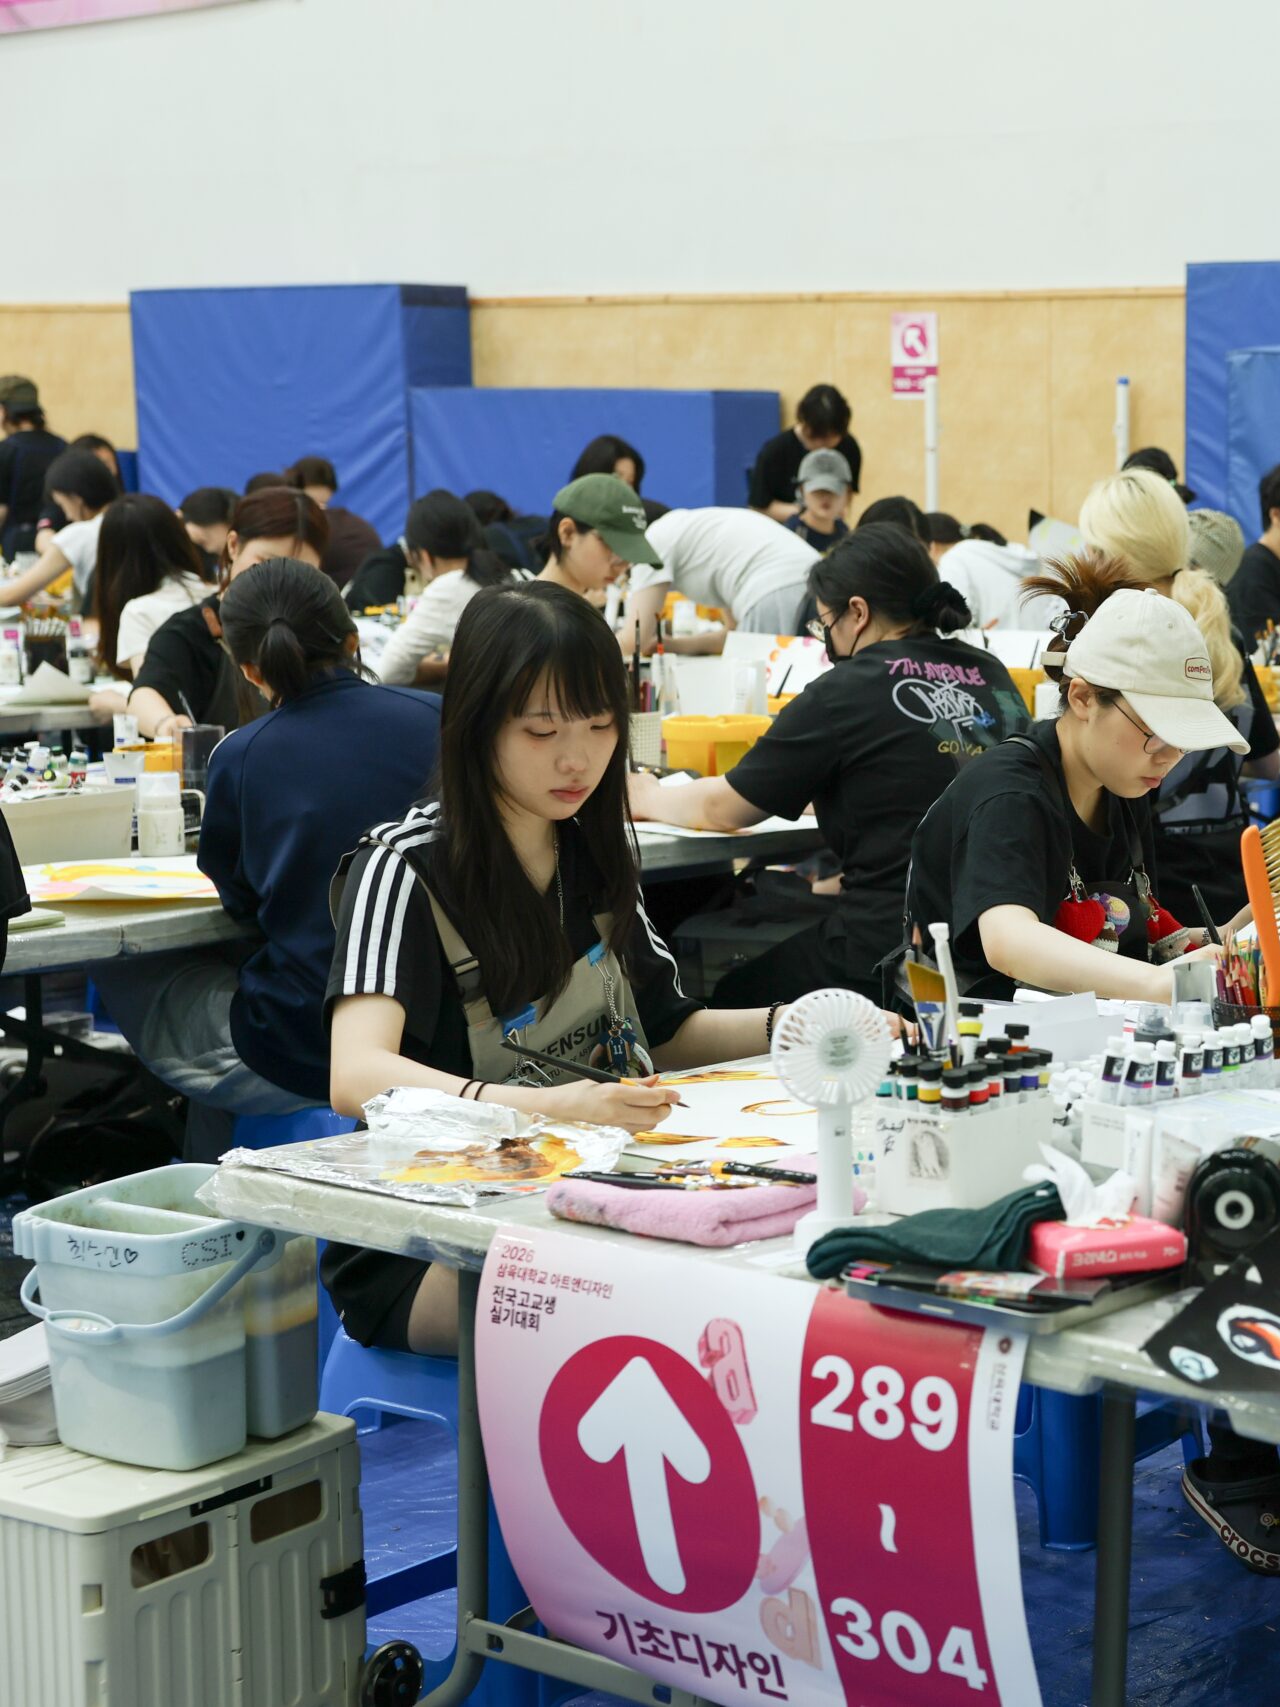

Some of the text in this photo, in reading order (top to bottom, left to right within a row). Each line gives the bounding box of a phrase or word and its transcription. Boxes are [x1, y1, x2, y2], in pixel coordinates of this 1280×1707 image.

[937, 740, 984, 756] GOYA
[181, 1233, 233, 1266] CSI
[497, 1264, 549, 1286] 삼육대학교
[492, 1285, 558, 1315] 전국고교생
[490, 1305, 541, 1332] 실기대회
[809, 1354, 958, 1453] 289
[1220, 1524, 1280, 1569] crocs
[595, 1608, 789, 1701] 기초디자인
[829, 1596, 988, 1692] 304
